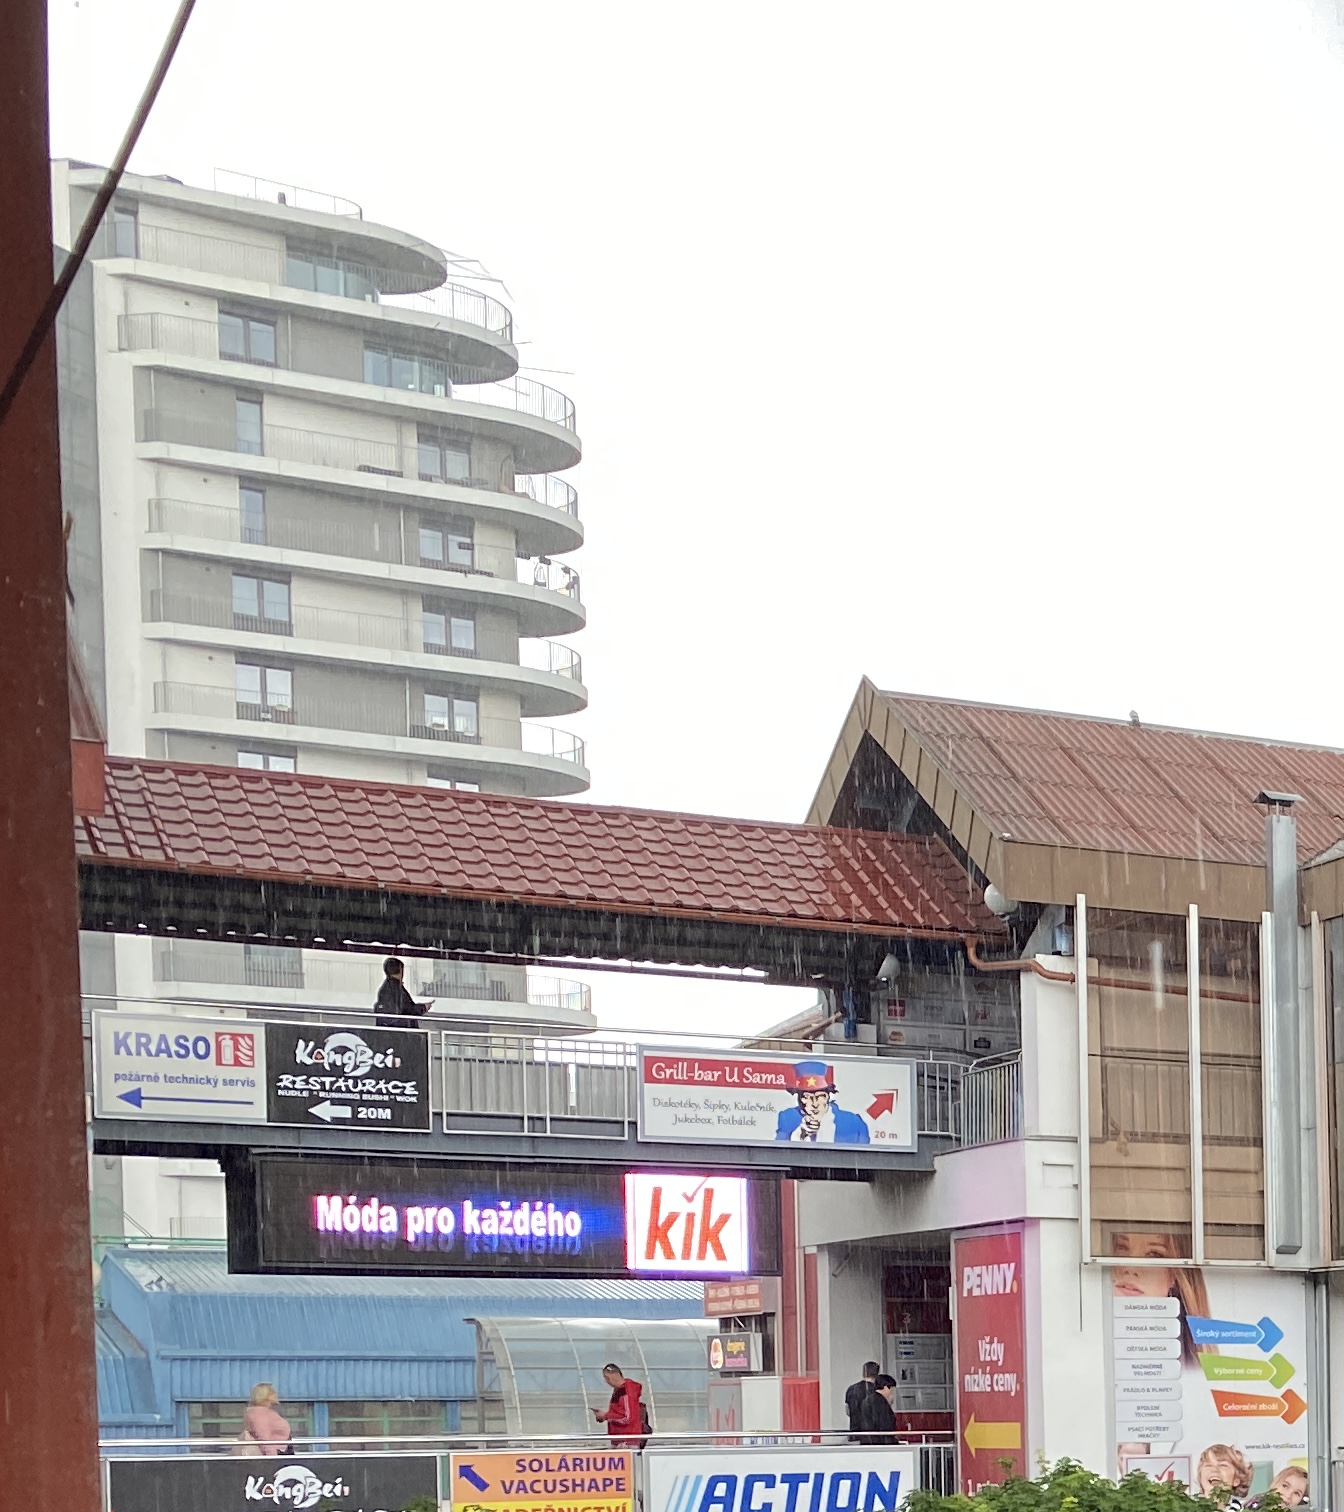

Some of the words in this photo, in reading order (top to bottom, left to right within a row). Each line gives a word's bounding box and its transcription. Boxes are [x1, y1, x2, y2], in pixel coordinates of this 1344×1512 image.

[113, 1031, 211, 1060] KRASO
[114, 1071, 160, 1084] požárně
[164, 1073, 218, 1088] technický
[222, 1076, 256, 1088] servis
[651, 1062, 722, 1082] Grill-bar
[725, 1066, 738, 1083] U
[742, 1067, 786, 1086] Sama
[276, 1074, 418, 1095] RESTAURACE
[278, 1089, 309, 1098] NUDLE
[396, 1095, 417, 1103] WOK
[357, 1106, 391, 1120] 20M
[874, 1130, 886, 1139] 20
[316, 1194, 397, 1233] Móda
[405, 1205, 454, 1243] pro
[463, 1199, 582, 1237] každého
[644, 1177, 733, 1261] kik
[1221, 1329, 1257, 1338] sortiment
[978, 1336, 1004, 1366] Vždy
[964, 1366, 991, 1393] nízké
[1246, 1368, 1263, 1376] ceny
[515, 1454, 626, 1473] SOLÁRIUM
[501, 1477, 626, 1494] VACUSHAPE
